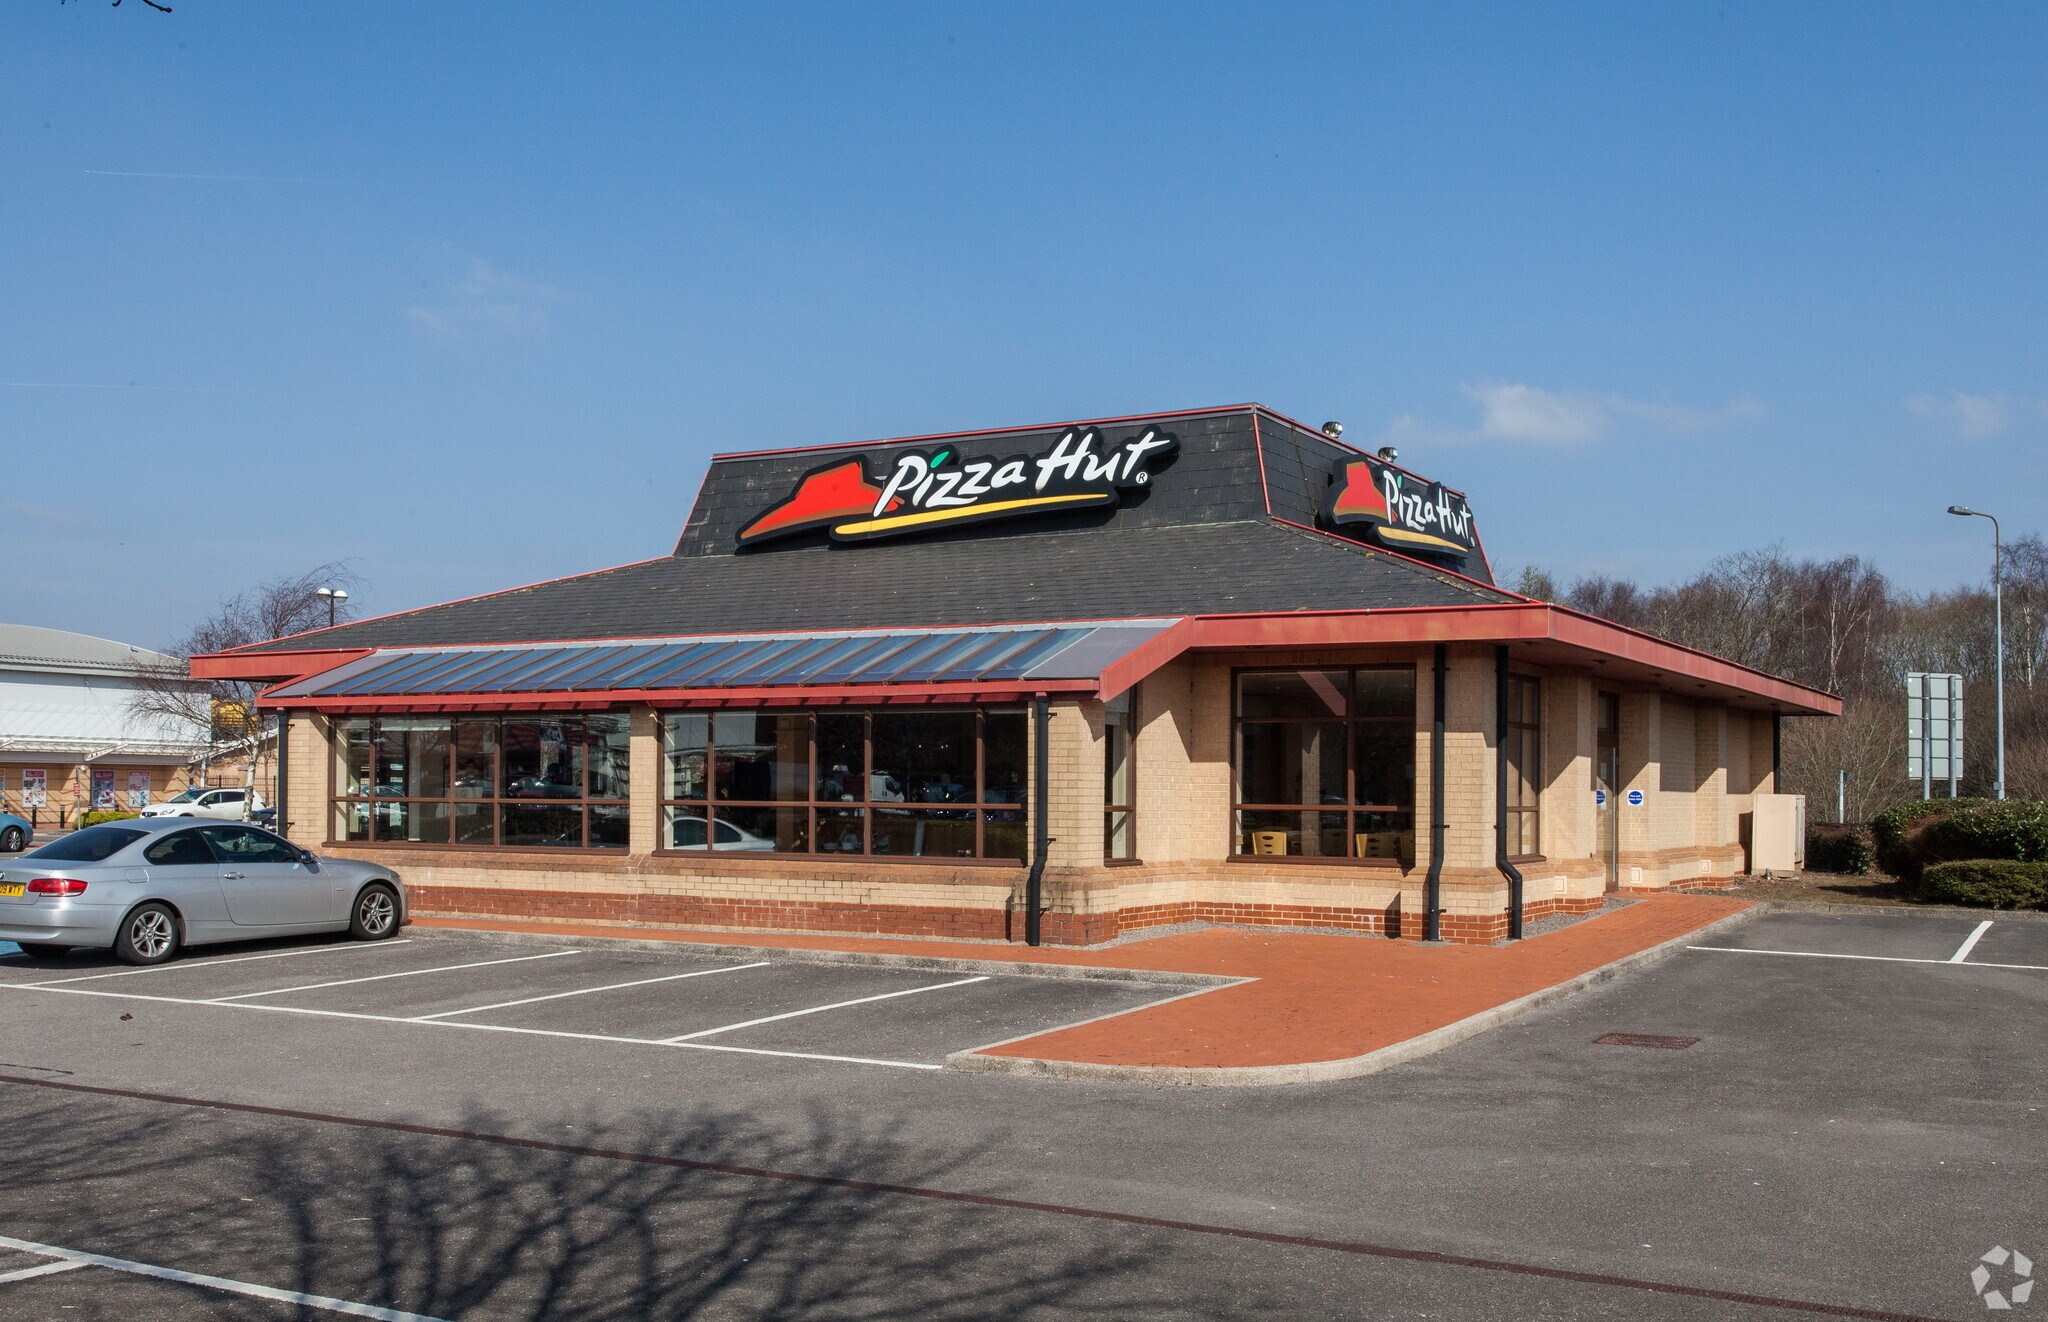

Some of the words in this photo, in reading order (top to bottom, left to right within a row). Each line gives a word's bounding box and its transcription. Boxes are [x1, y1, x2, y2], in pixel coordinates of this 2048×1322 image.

[873, 451, 1026, 518] Pizza
[1035, 431, 1170, 490] Hut
[1383, 470, 1438, 532] Pizza
[1436, 487, 1472, 540] Hut
